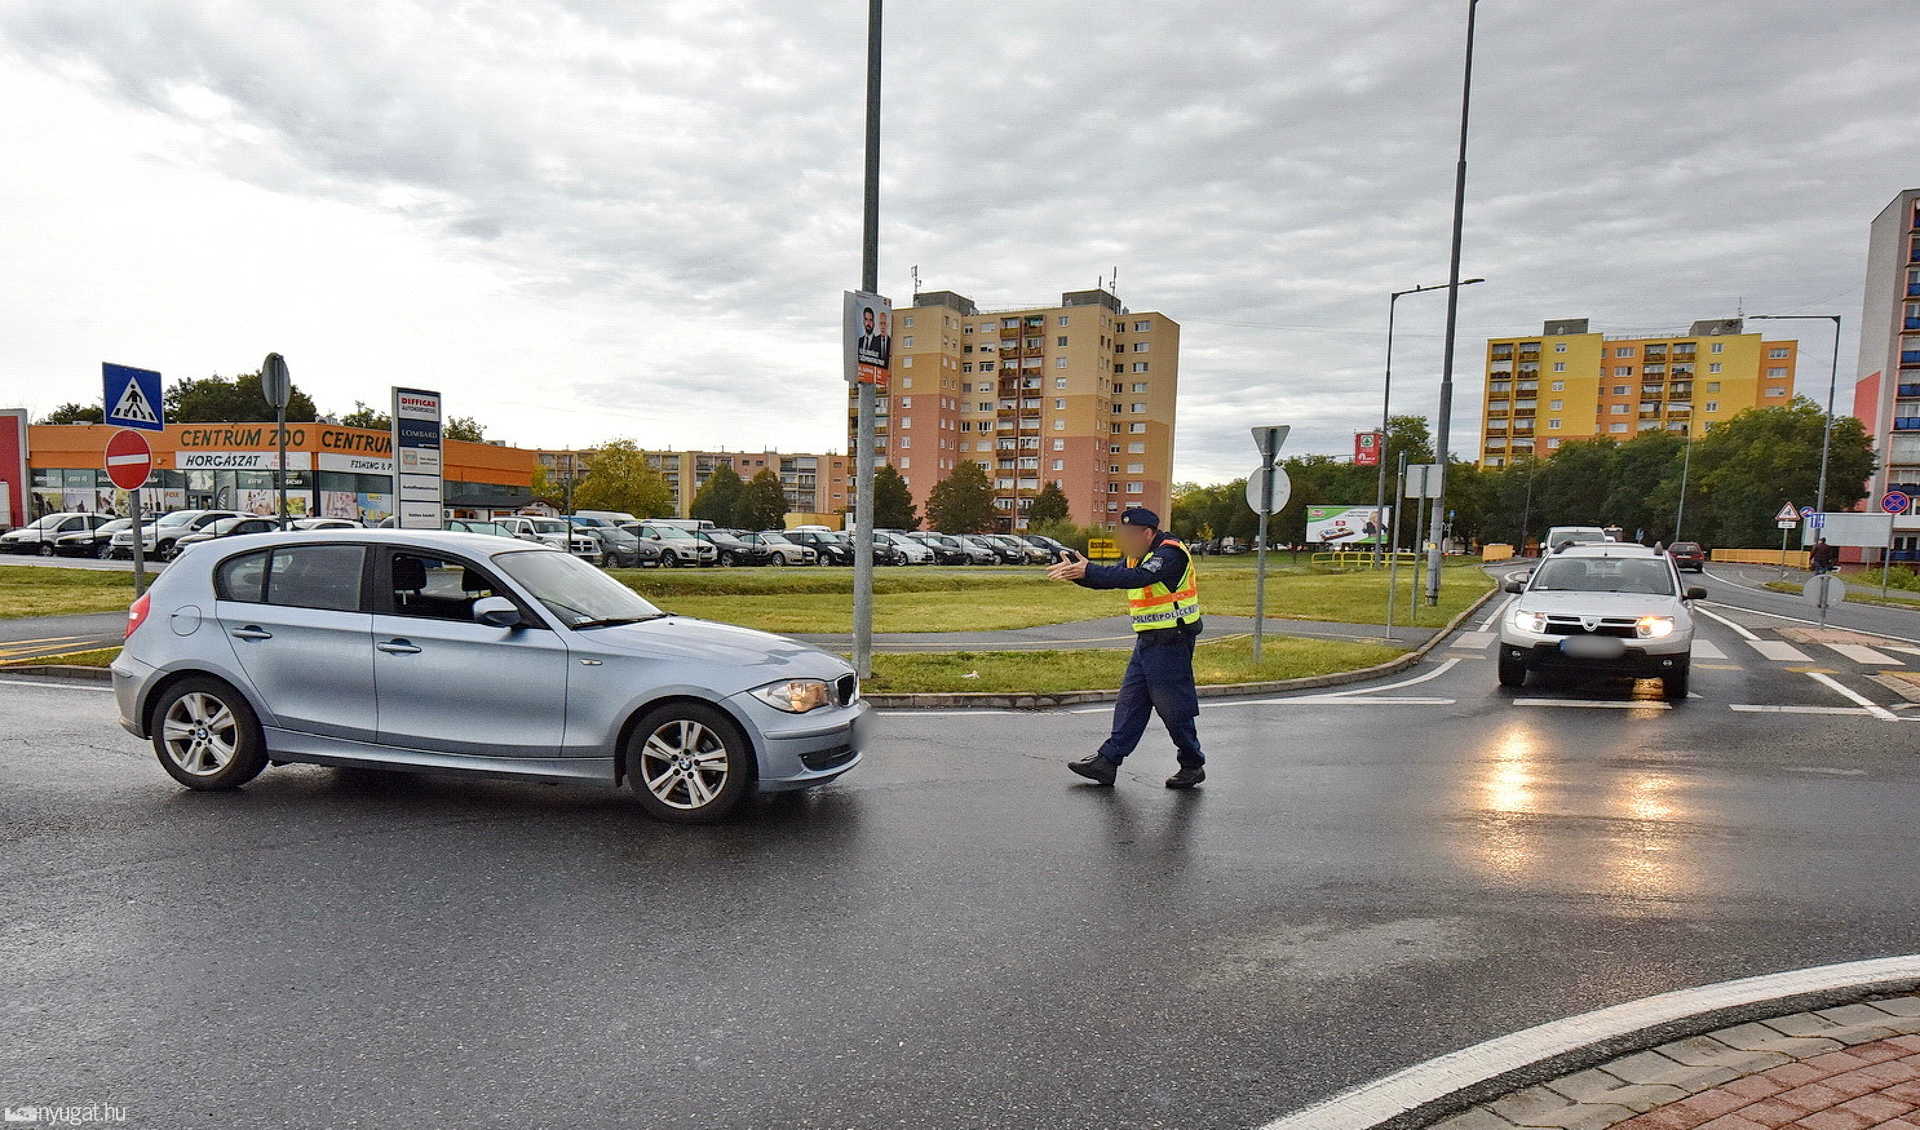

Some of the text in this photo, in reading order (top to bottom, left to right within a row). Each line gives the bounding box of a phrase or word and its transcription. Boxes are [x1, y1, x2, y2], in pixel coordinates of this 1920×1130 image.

[180, 428, 305, 446] CENTRUM ZOO
[401, 429, 438, 439] LOMBARD
[185, 452, 261, 467] HORGÁSZAT
[350, 460, 379, 470] FISHING
